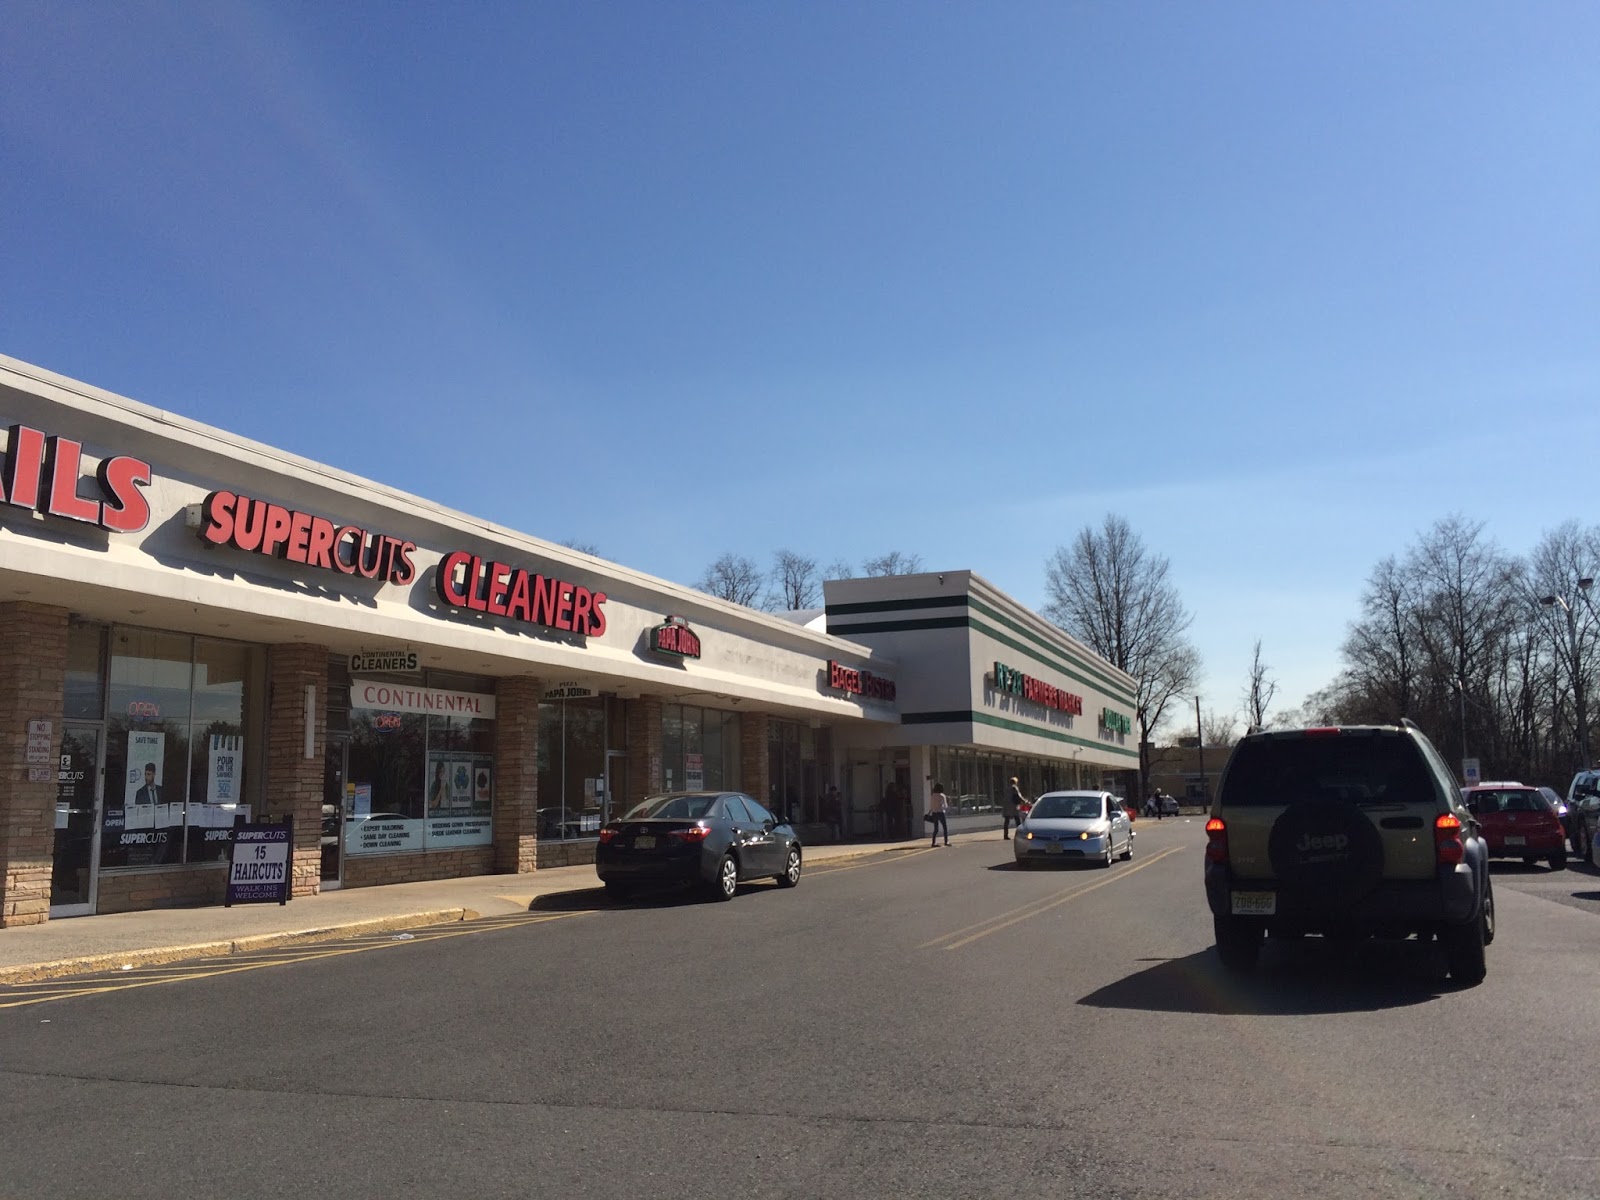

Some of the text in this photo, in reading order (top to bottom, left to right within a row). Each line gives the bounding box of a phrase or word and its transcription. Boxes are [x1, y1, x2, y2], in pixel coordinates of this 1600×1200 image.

[0, 424, 151, 534] ILS
[205, 490, 417, 586] SUPERCUTS
[436, 550, 607, 638] CLEANERS
[658, 628, 677, 651] PAPA
[352, 653, 417, 670] CLEANERS
[362, 651, 406, 659] CONTINENTAL
[828, 660, 897, 701] BAGEL BISTRO
[545, 689, 565, 698] PAPA
[1023, 674, 1058, 709] FARMERS
[364, 686, 482, 713] CONTINENTAL
[128, 701, 160, 717] OPEN
[37, 723, 46, 732] NO
[375, 714, 401, 729] OPEN
[30, 733, 51, 741] STOPPING
[217, 756, 234, 765] POUR
[58, 771, 84, 780] ERCUTS
[105, 818, 125, 827] OPEN
[120, 832, 168, 845] SUPERCUTS
[236, 831, 287, 841] SUPERCUTS
[363, 833, 377, 841] SAME
[1296, 833, 1349, 851] Jeep
[254, 845, 267, 860] 15
[234, 862, 284, 881] HAIRCUTS
[236, 885, 278, 893] WALK-INS
